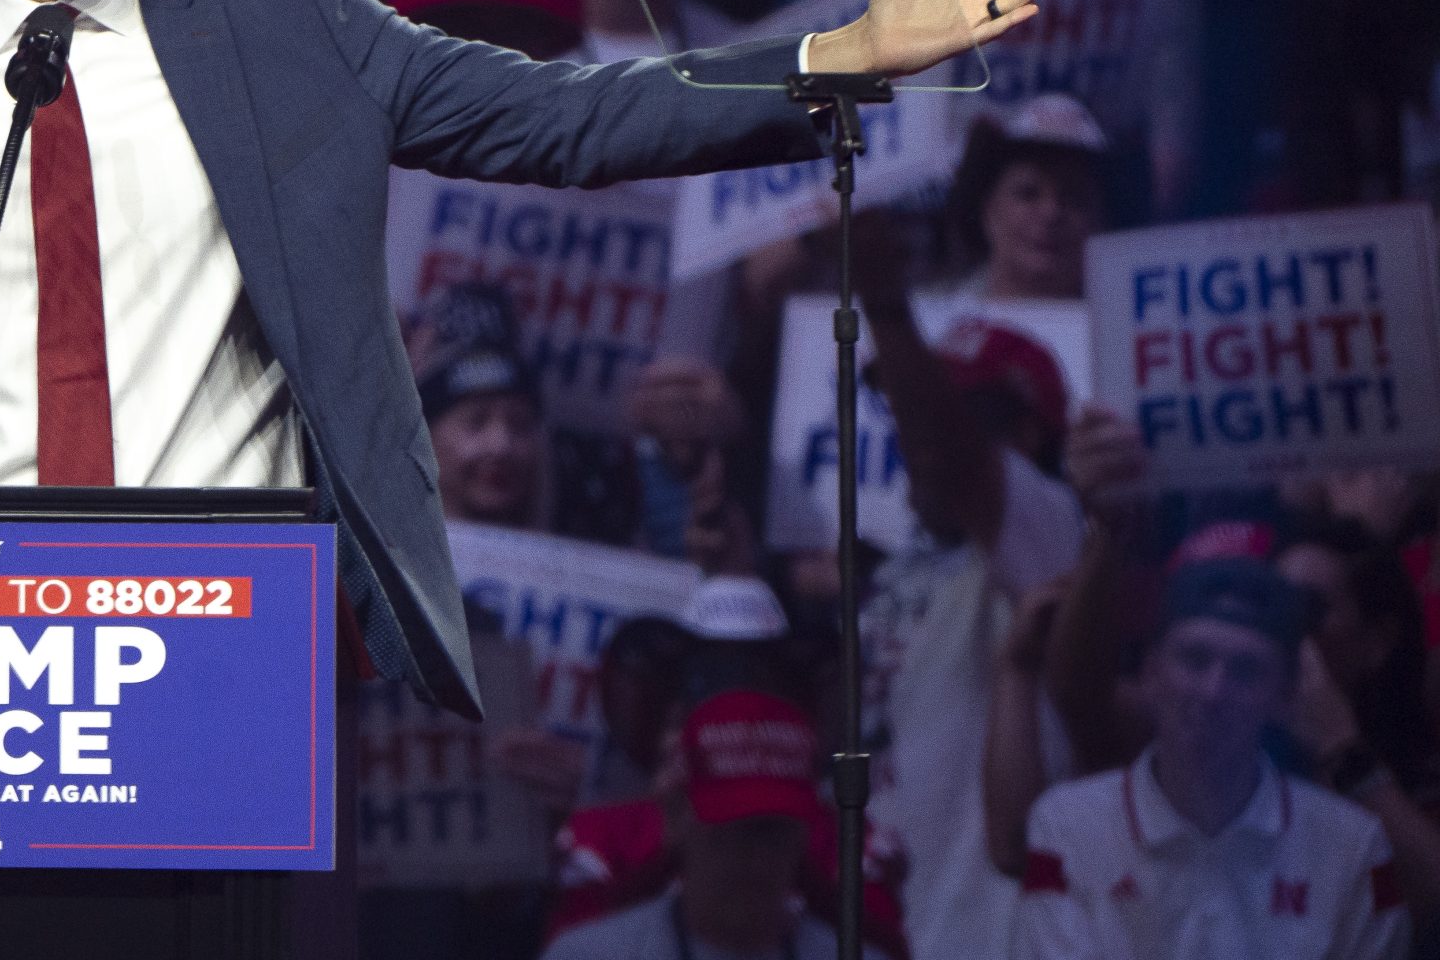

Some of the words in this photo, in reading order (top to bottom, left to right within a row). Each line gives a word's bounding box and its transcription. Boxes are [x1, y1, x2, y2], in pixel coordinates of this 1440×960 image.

[1132, 243, 1381, 322] FIGHT!
[1133, 308, 1391, 387] FIGHT!
[1137, 373, 1402, 450] FIGHT!
[8, 578, 72, 615] TO
[85, 578, 233, 616] 88022
[42, 784, 137, 804] AGAIN!
